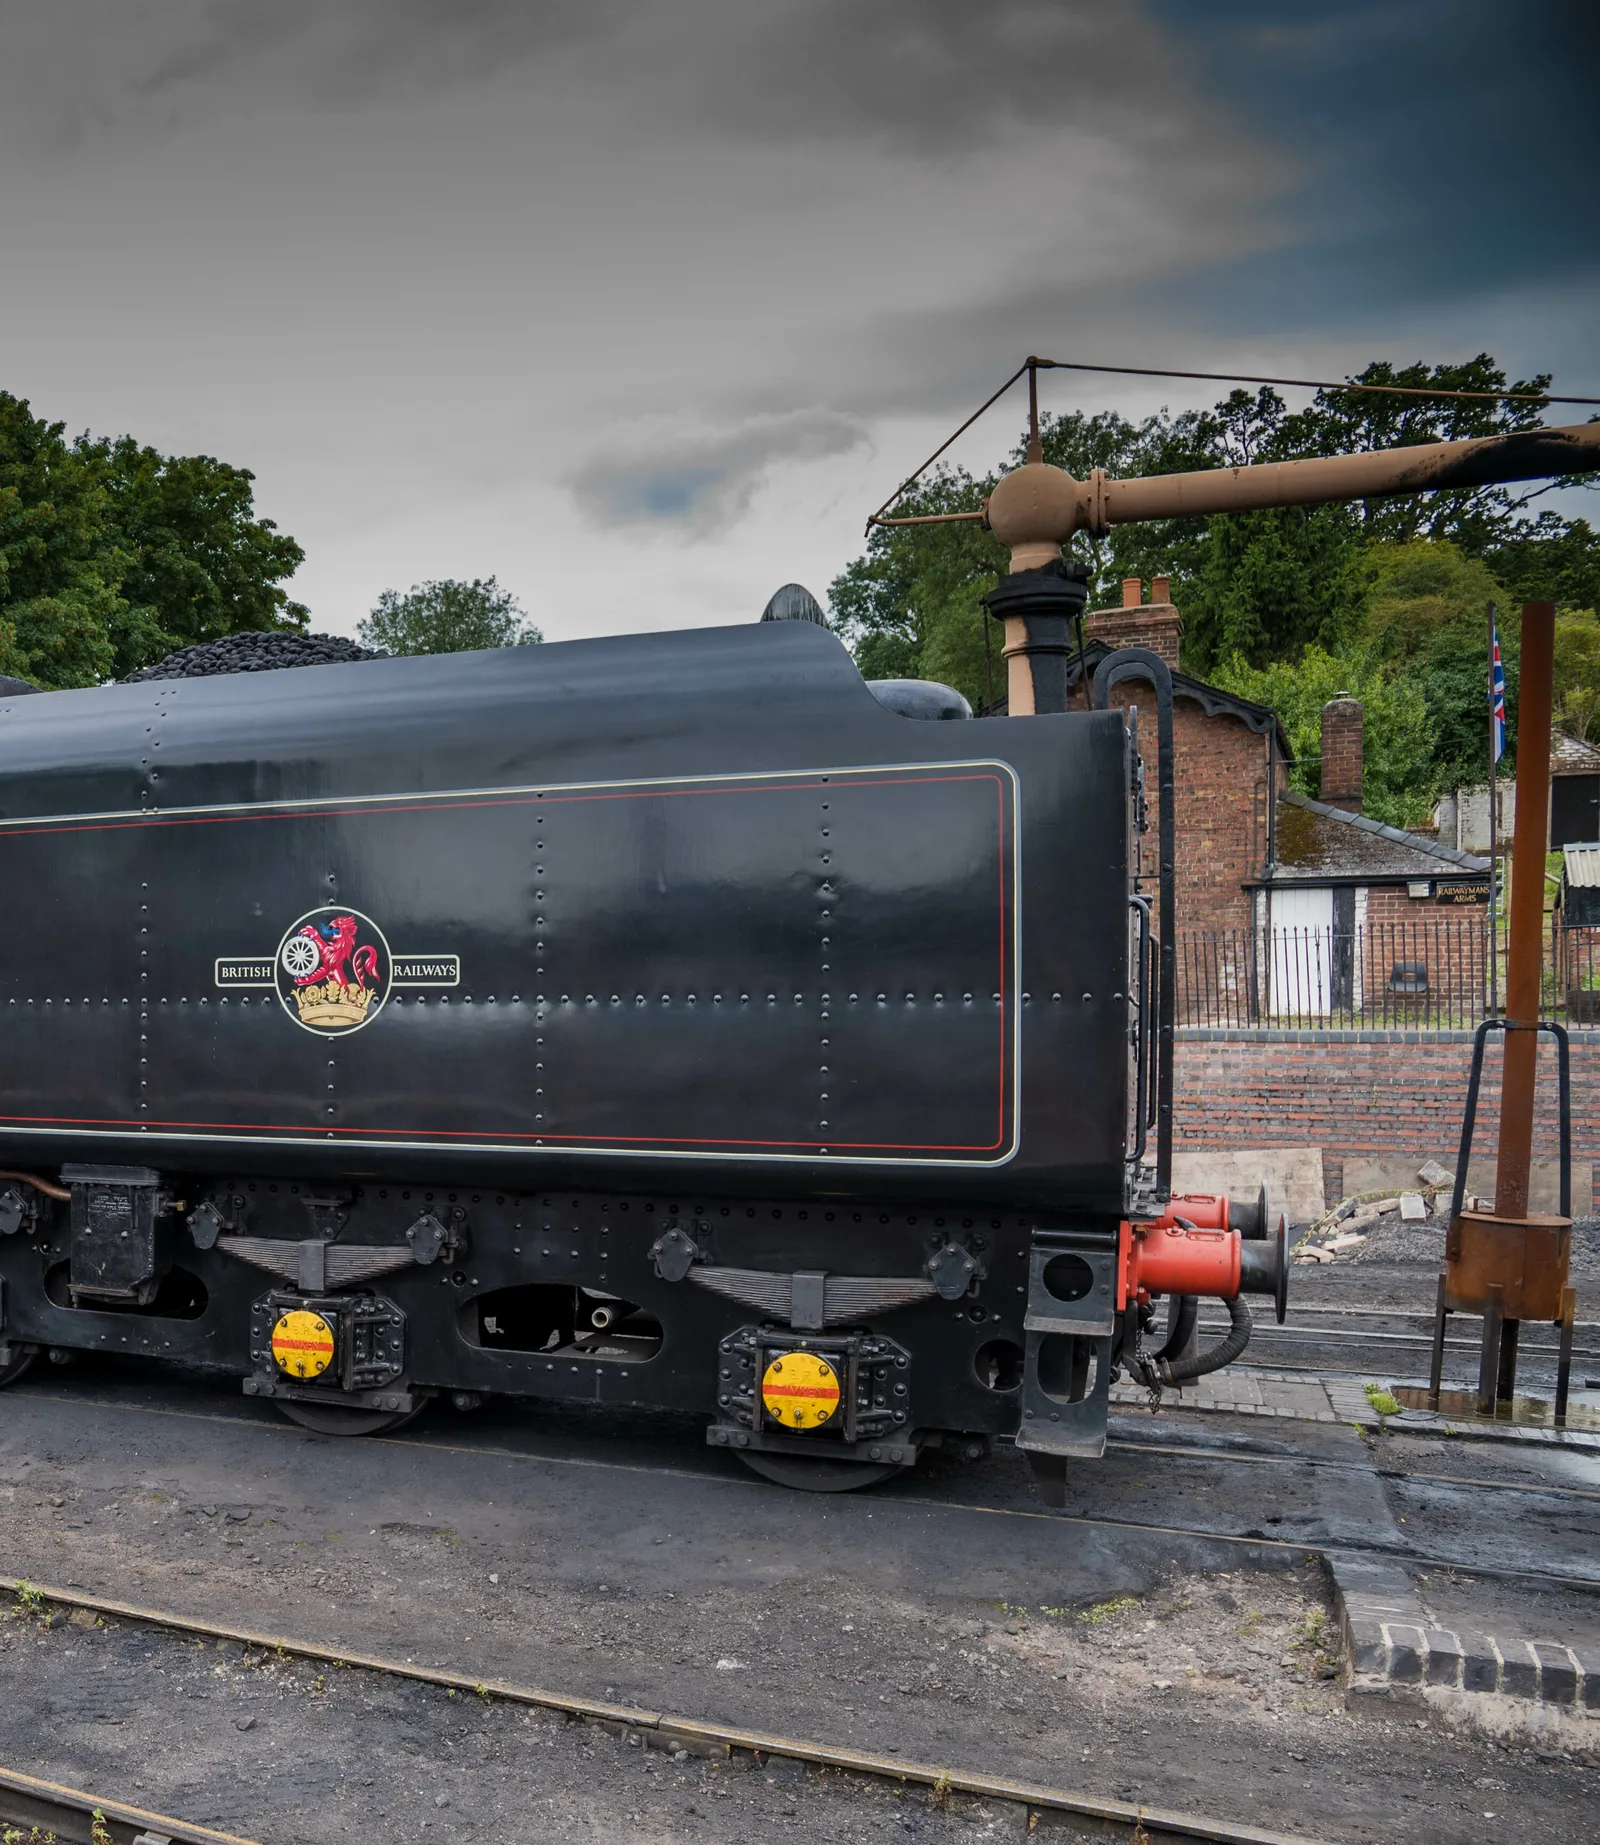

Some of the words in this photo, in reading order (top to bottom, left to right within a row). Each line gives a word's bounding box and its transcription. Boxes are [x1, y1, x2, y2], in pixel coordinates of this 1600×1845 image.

[1438, 886, 1490, 895] RAILWAYMANS
[222, 966, 271, 978] BRITISH
[393, 964, 456, 977] RAILWAYS
